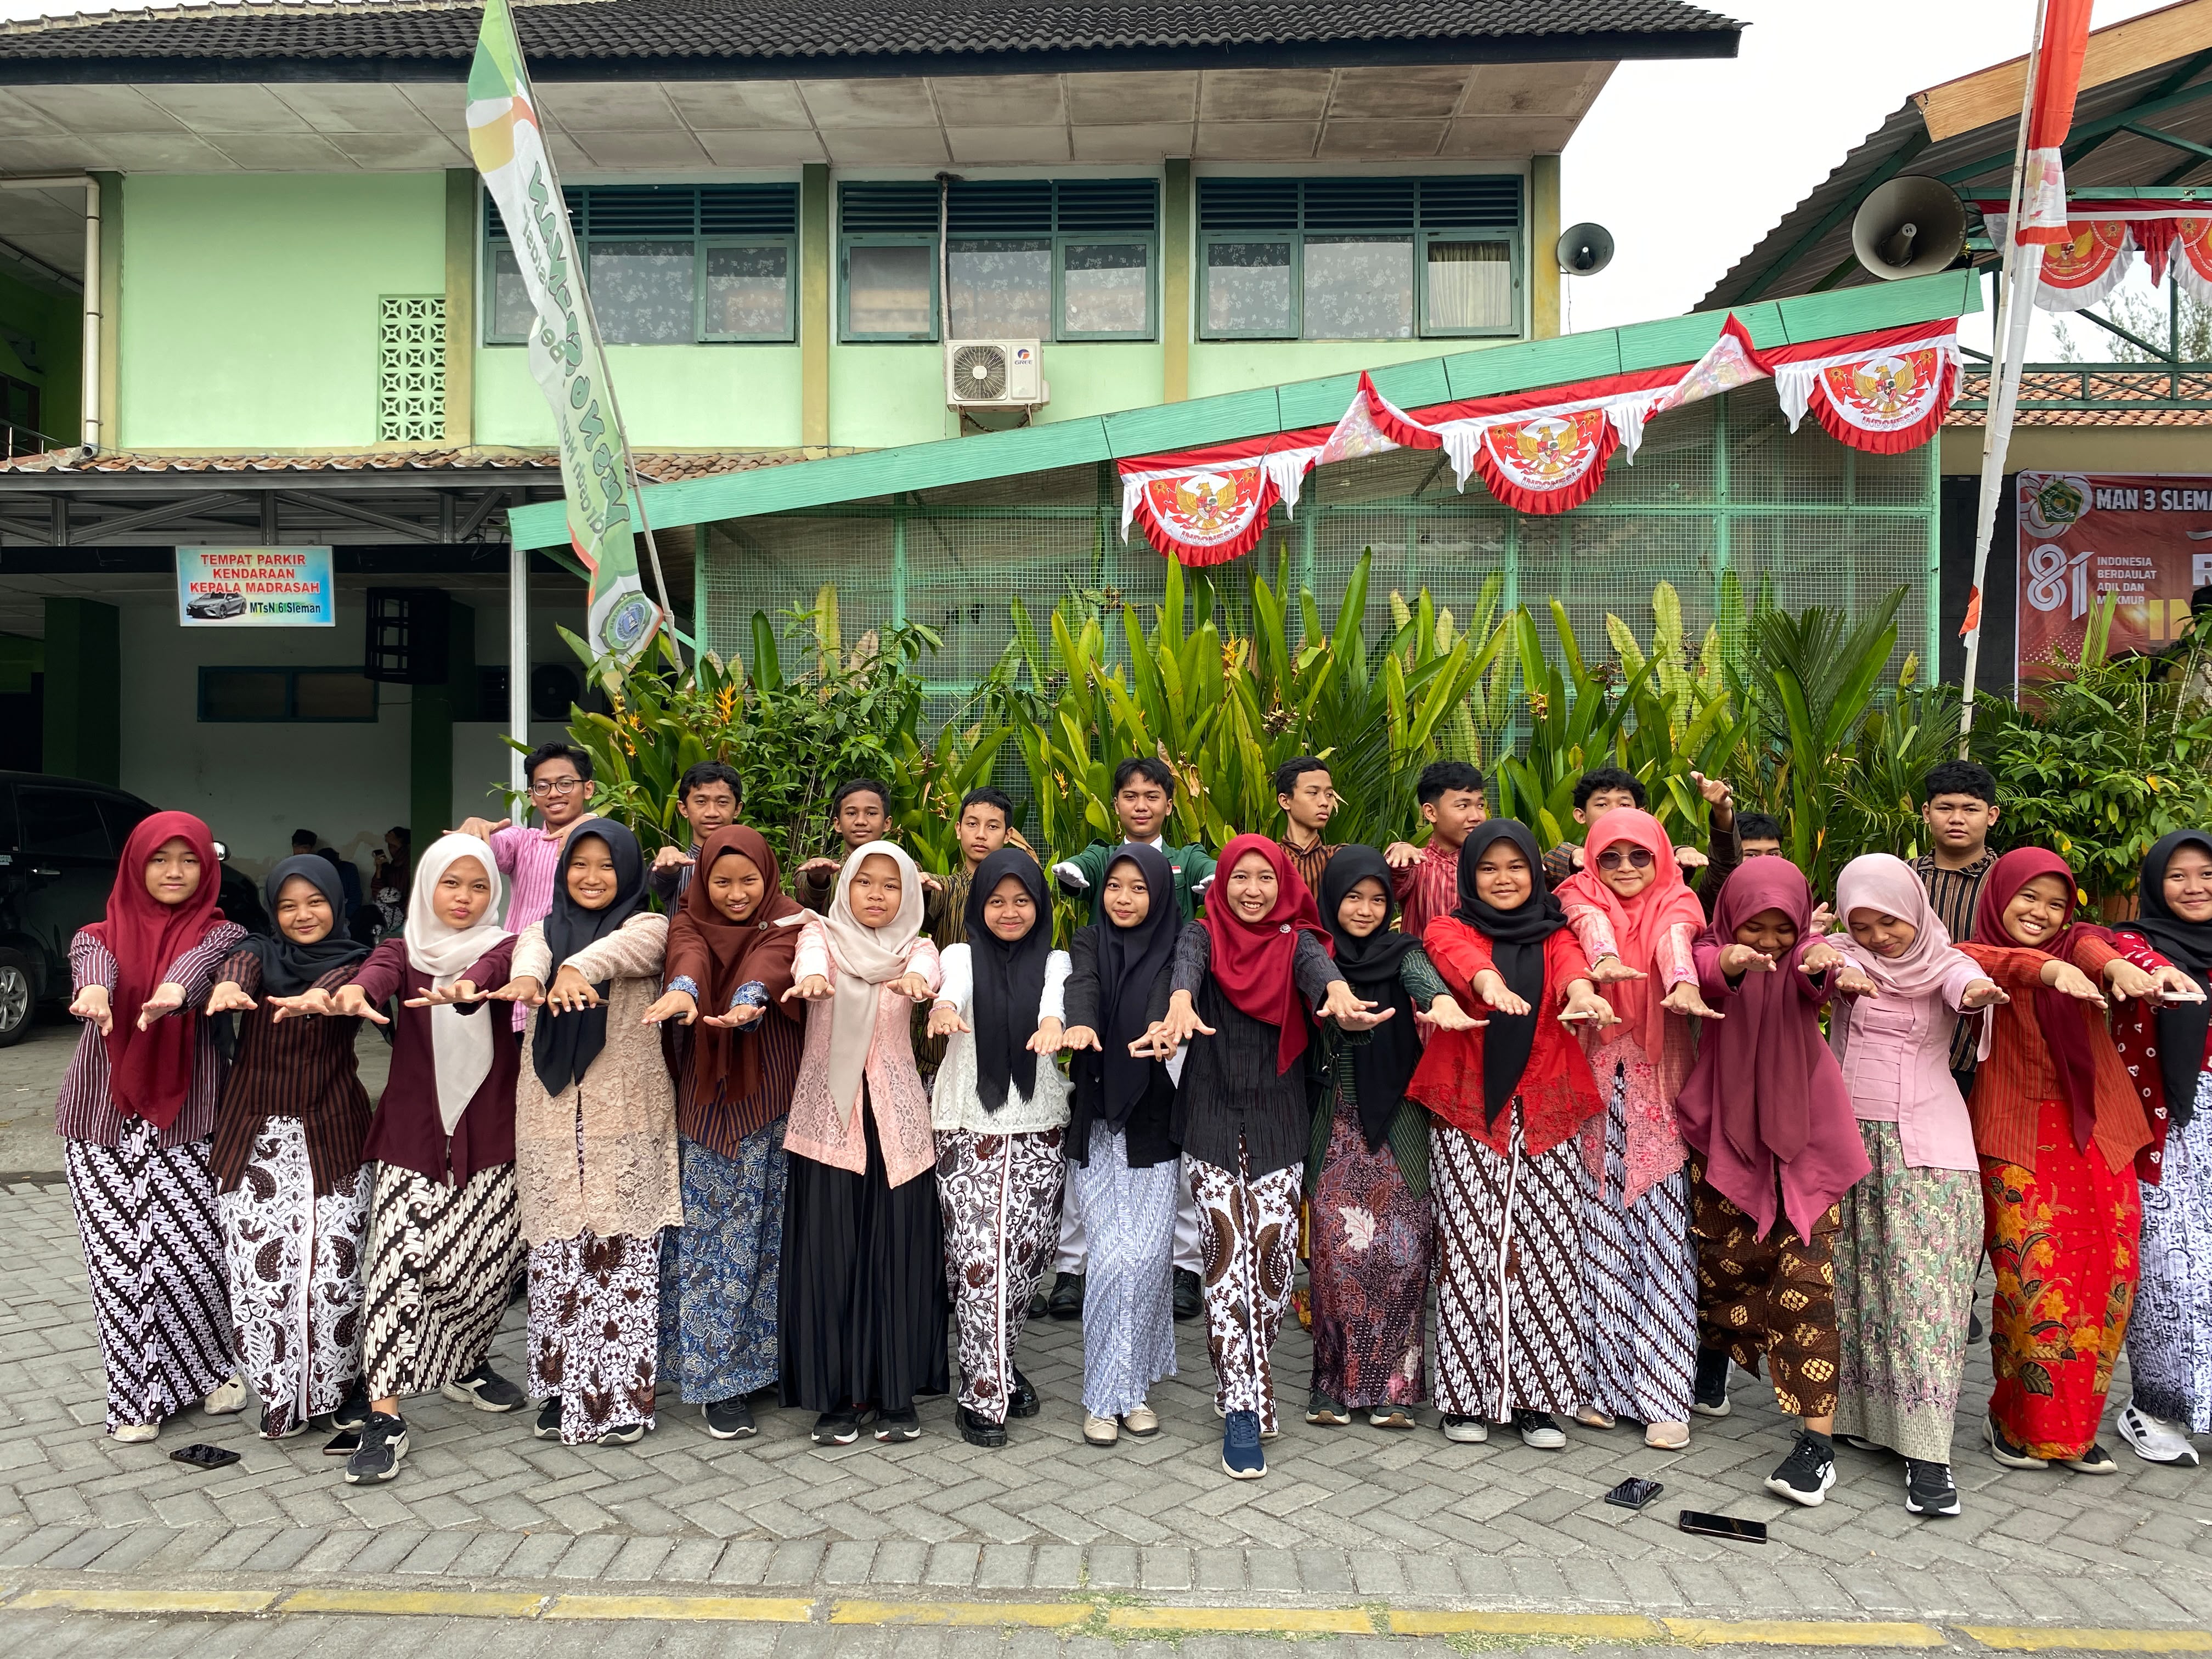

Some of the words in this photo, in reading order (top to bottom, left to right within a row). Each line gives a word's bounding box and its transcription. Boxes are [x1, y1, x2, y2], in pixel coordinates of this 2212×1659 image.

[1861, 407, 1925, 429] INDONESIA
[1521, 467, 1585, 490] INDONESIA
[2096, 489, 2138, 509] MAN
[2144, 489, 2156, 510] 3
[1180, 524, 1243, 545] INDONESIA
[201, 555, 252, 565] TEMPAT
[257, 555, 306, 565] PARKIR
[2097, 556, 2153, 566] INDONESIA
[213, 568, 295, 579] KENDARAAN
[2097, 569, 2157, 579] BERDAULAT
[190, 583, 241, 592] KEPALA
[246, 583, 319, 592] MADRASAH
[2097, 582, 2121, 591] ADIL
[2123, 583, 2145, 592] DAN
[2097, 595, 2145, 605] MKMUR
[250, 602, 274, 613] MTsN
[278, 602, 284, 613] 6
[287, 602, 320, 613] Sleman
